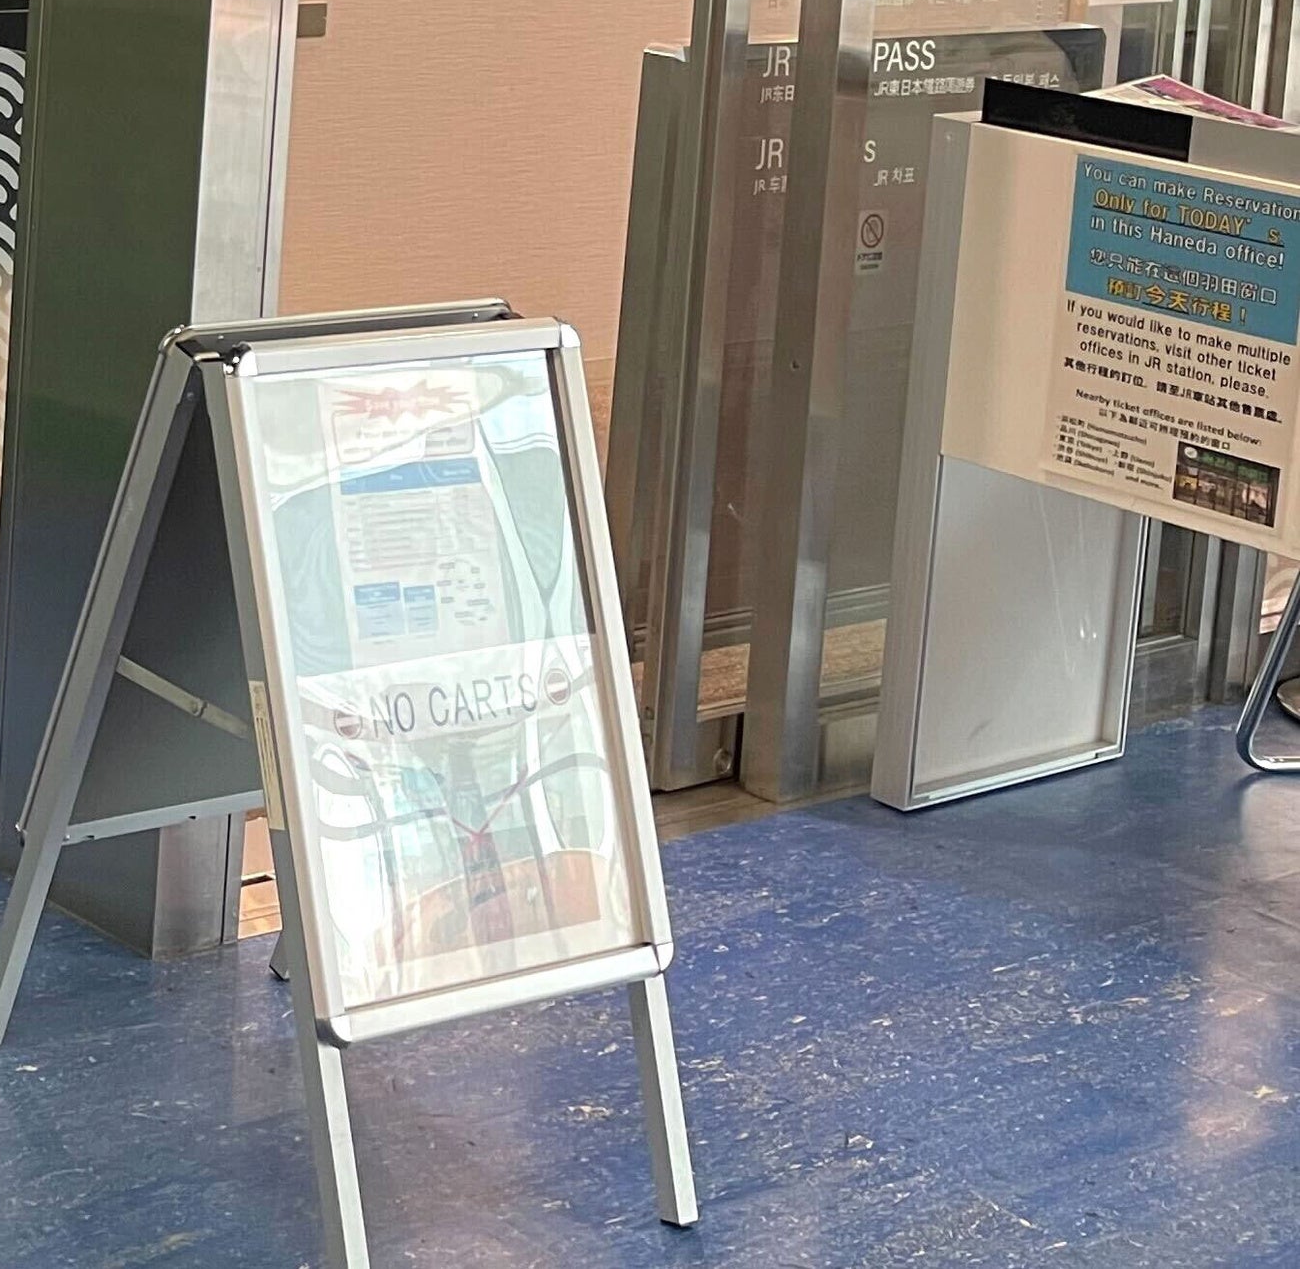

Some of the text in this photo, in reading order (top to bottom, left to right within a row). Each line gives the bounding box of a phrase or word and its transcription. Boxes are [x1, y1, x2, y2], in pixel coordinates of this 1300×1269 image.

[762, 39, 936, 78] JR PASS
[755, 138, 785, 171] JR
[1083, 162, 1111, 182] You
[1119, 173, 1146, 188] can
[1153, 179, 1196, 200] make
[1095, 189, 1135, 214] Only
[1143, 200, 1169, 220] for
[1090, 216, 1285, 271] in this Haneda office!
[1067, 299, 1292, 368] If you would like to make multiple
[1080, 339, 1124, 362] offices
[1128, 350, 1140, 365] in
[1144, 356, 1162, 372] JR
[1165, 342, 1192, 361] visit
[1197, 351, 1234, 371] other
[1238, 360, 1277, 382] ticket
[1075, 388, 1111, 407] Nearby
[1113, 397, 1141, 414] ticket
[1142, 405, 1176, 424] offices
[1178, 417, 1195, 429] are
[1196, 419, 1226, 437] listed
[368, 672, 539, 739] NO CARTS
